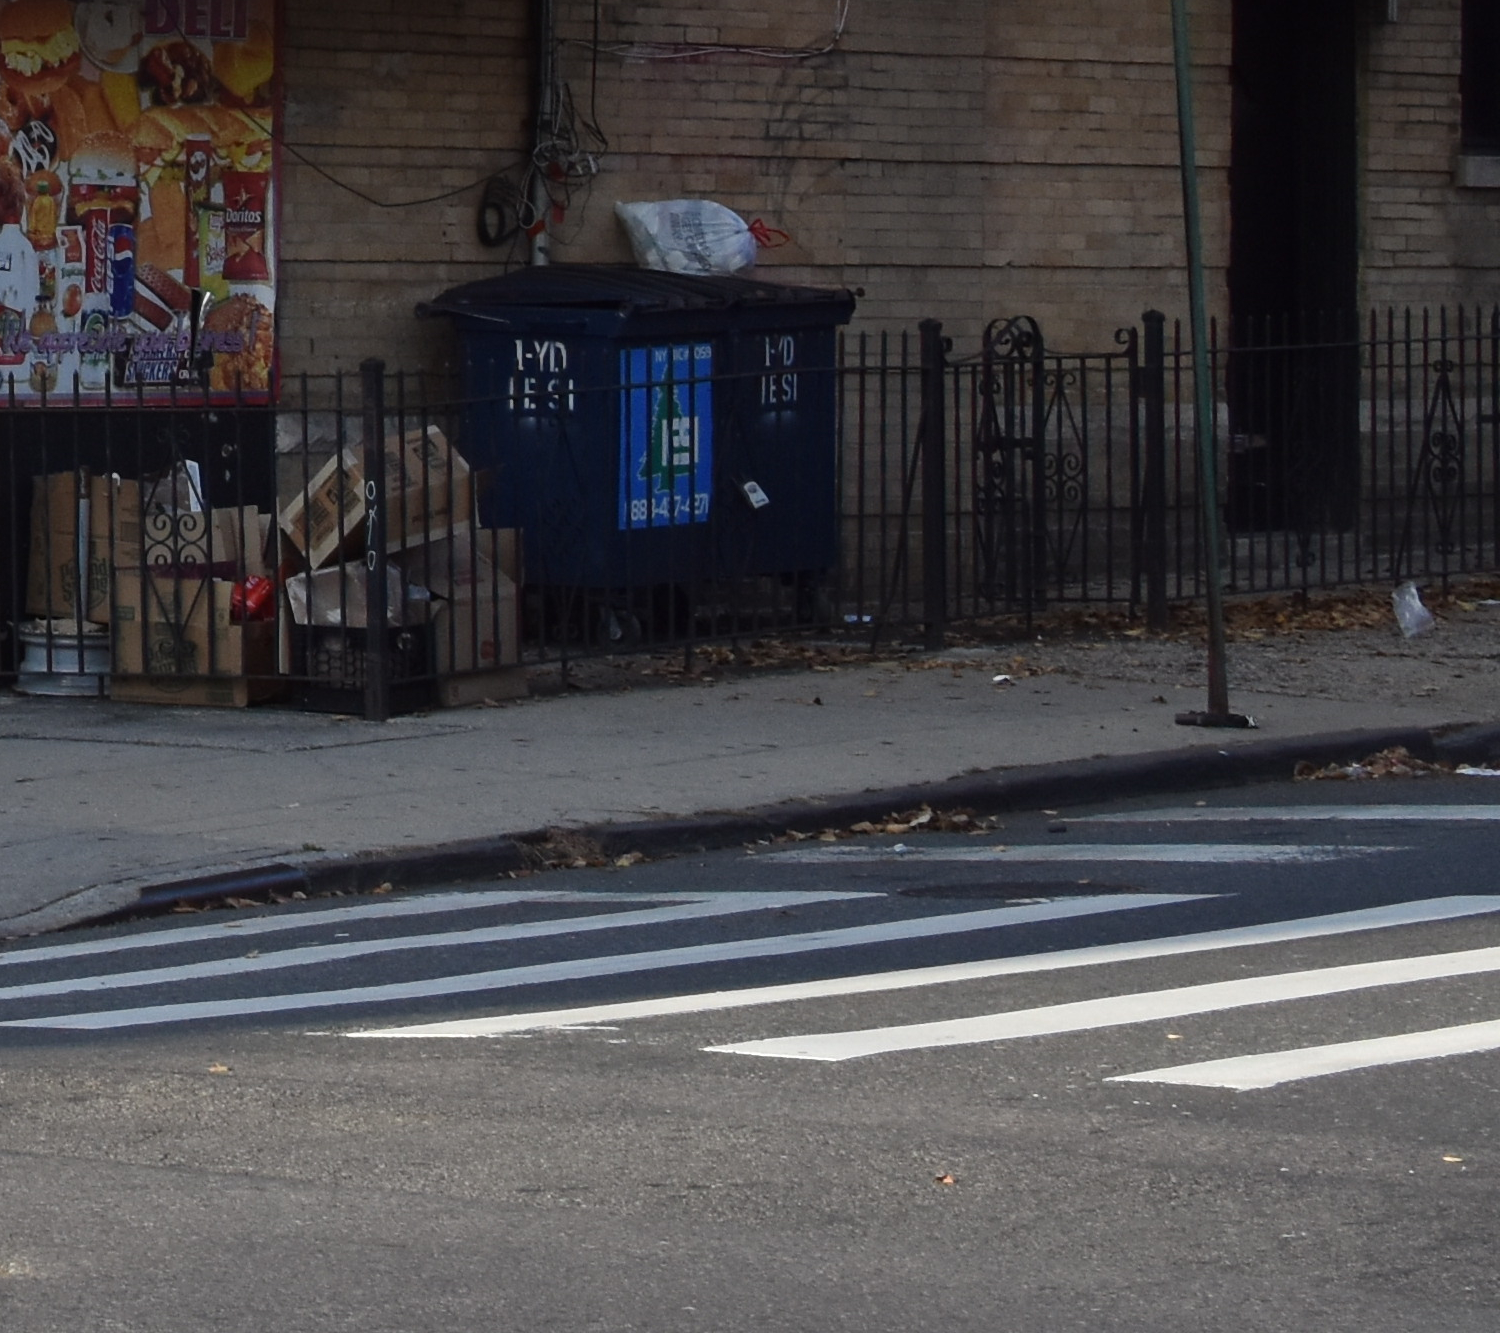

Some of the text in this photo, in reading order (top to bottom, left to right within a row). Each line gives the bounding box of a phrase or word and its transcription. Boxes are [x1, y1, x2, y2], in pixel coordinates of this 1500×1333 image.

[226, 209, 261, 223] Doritos
[509, 377, 574, 411] IESI
[761, 373, 797, 405] IESI
